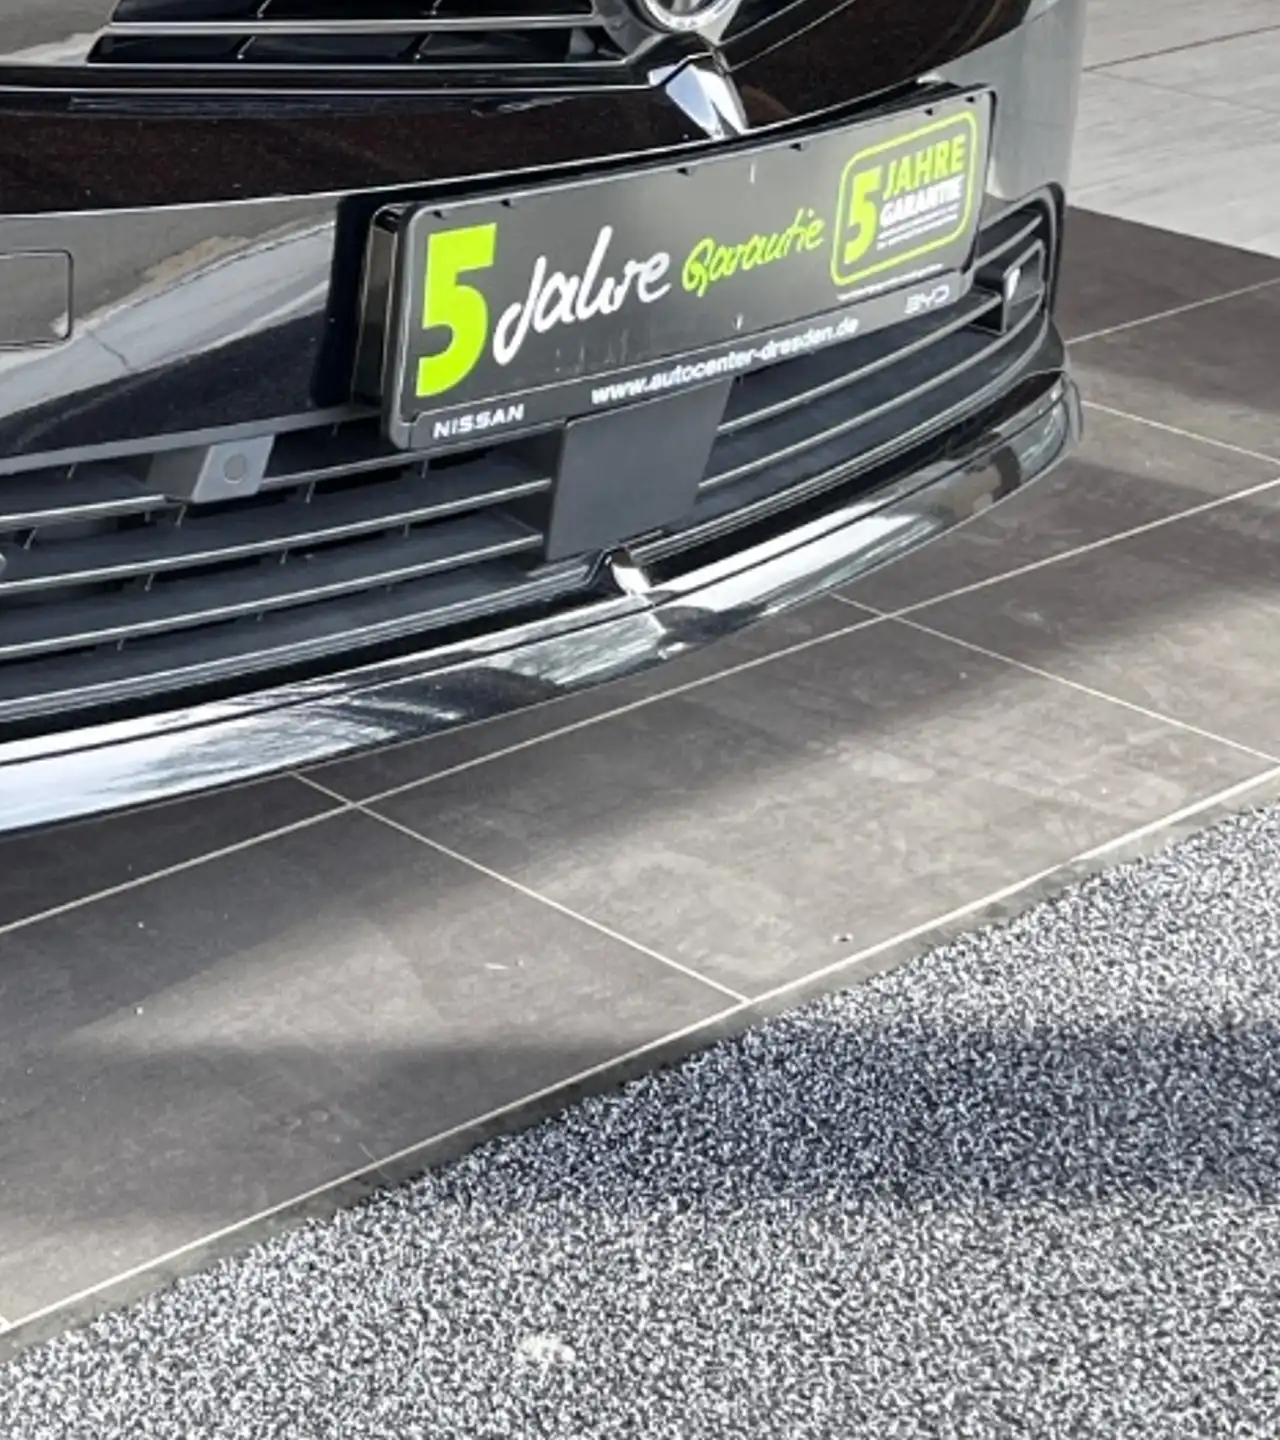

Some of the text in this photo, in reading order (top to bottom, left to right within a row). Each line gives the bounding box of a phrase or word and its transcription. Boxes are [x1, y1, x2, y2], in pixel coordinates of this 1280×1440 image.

[883, 133, 966, 201] JAHRE
[843, 165, 884, 264] 5
[415, 208, 826, 398] 5 Jahre Garantie
[903, 285, 950, 315] BYD
[591, 317, 860, 406] www.autocenter-dresden.de
[432, 403, 526, 440] NISSAN
